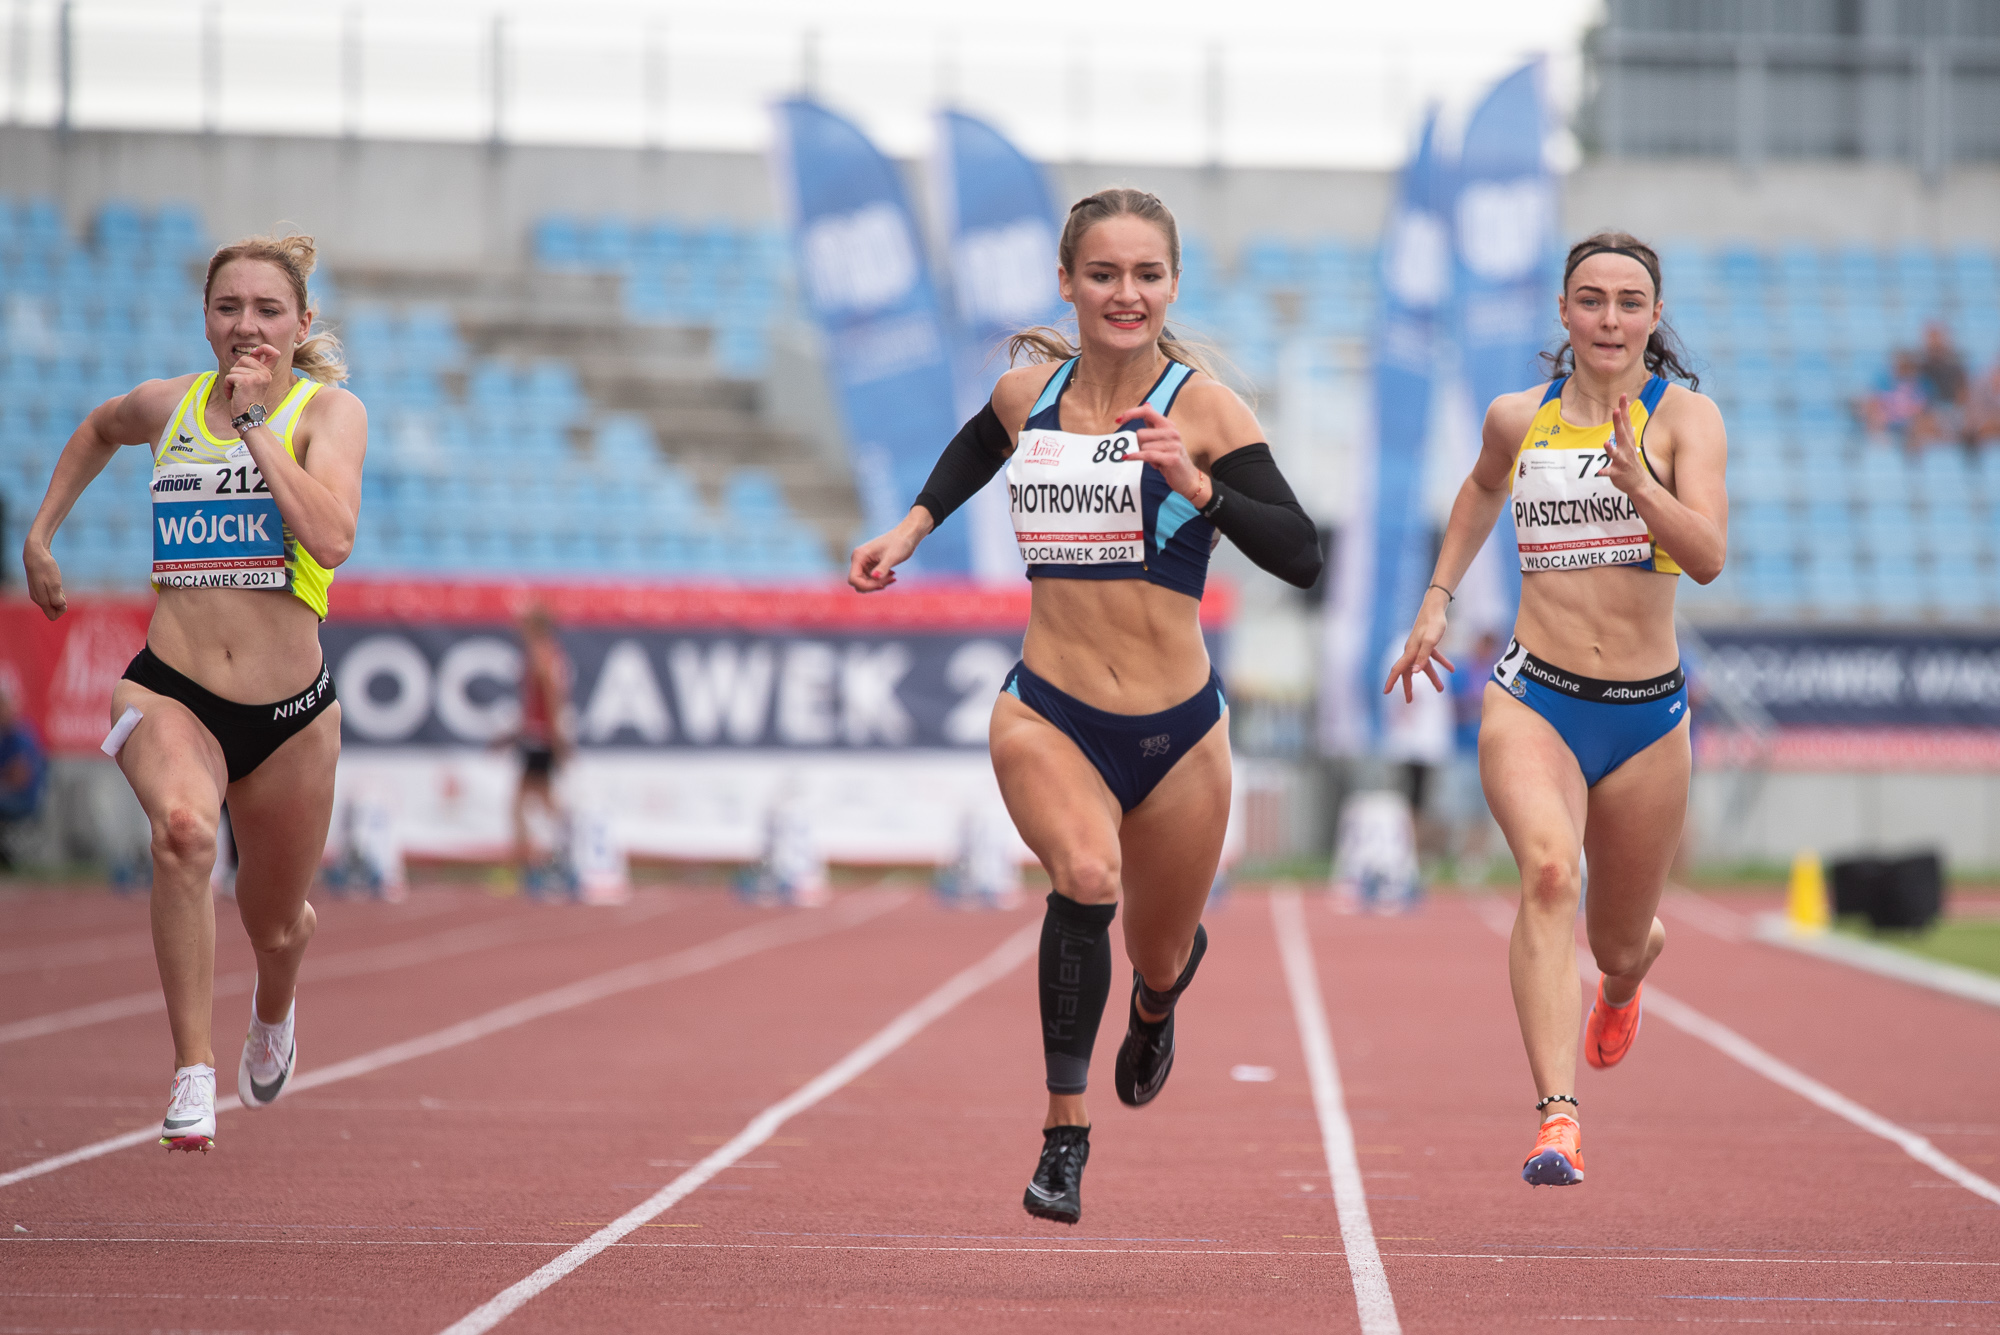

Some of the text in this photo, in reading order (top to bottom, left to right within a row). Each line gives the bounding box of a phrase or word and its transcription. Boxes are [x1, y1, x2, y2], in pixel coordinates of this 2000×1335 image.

[170, 444, 194, 453] erima
[1027, 439, 1065, 458] Anwil
[1092, 437, 1130, 463] 88
[1010, 484, 1136, 513] PIOTROWSKA
[1515, 492, 1640, 528] PIASZCZYŃSKA
[158, 509, 270, 545] WÓJCIK
[1089, 533, 1119, 541] POLSKI
[1099, 546, 1135, 560] 2021
[1549, 541, 1601, 551] MISTRZOSTWA
[1602, 538, 1629, 546] POLSKI
[183, 561, 233, 569] MISTRZOSTWA
[1525, 548, 1643, 569] WŁOCŁAWEK 2021
[157, 571, 276, 588] WŁOCŁAWEK 2021
[1521, 659, 1580, 693] RunaLine
[336, 634, 917, 747] OCAWEK
[1602, 679, 1676, 699] AdRunaLine
[273, 690, 316, 721] NIKE
